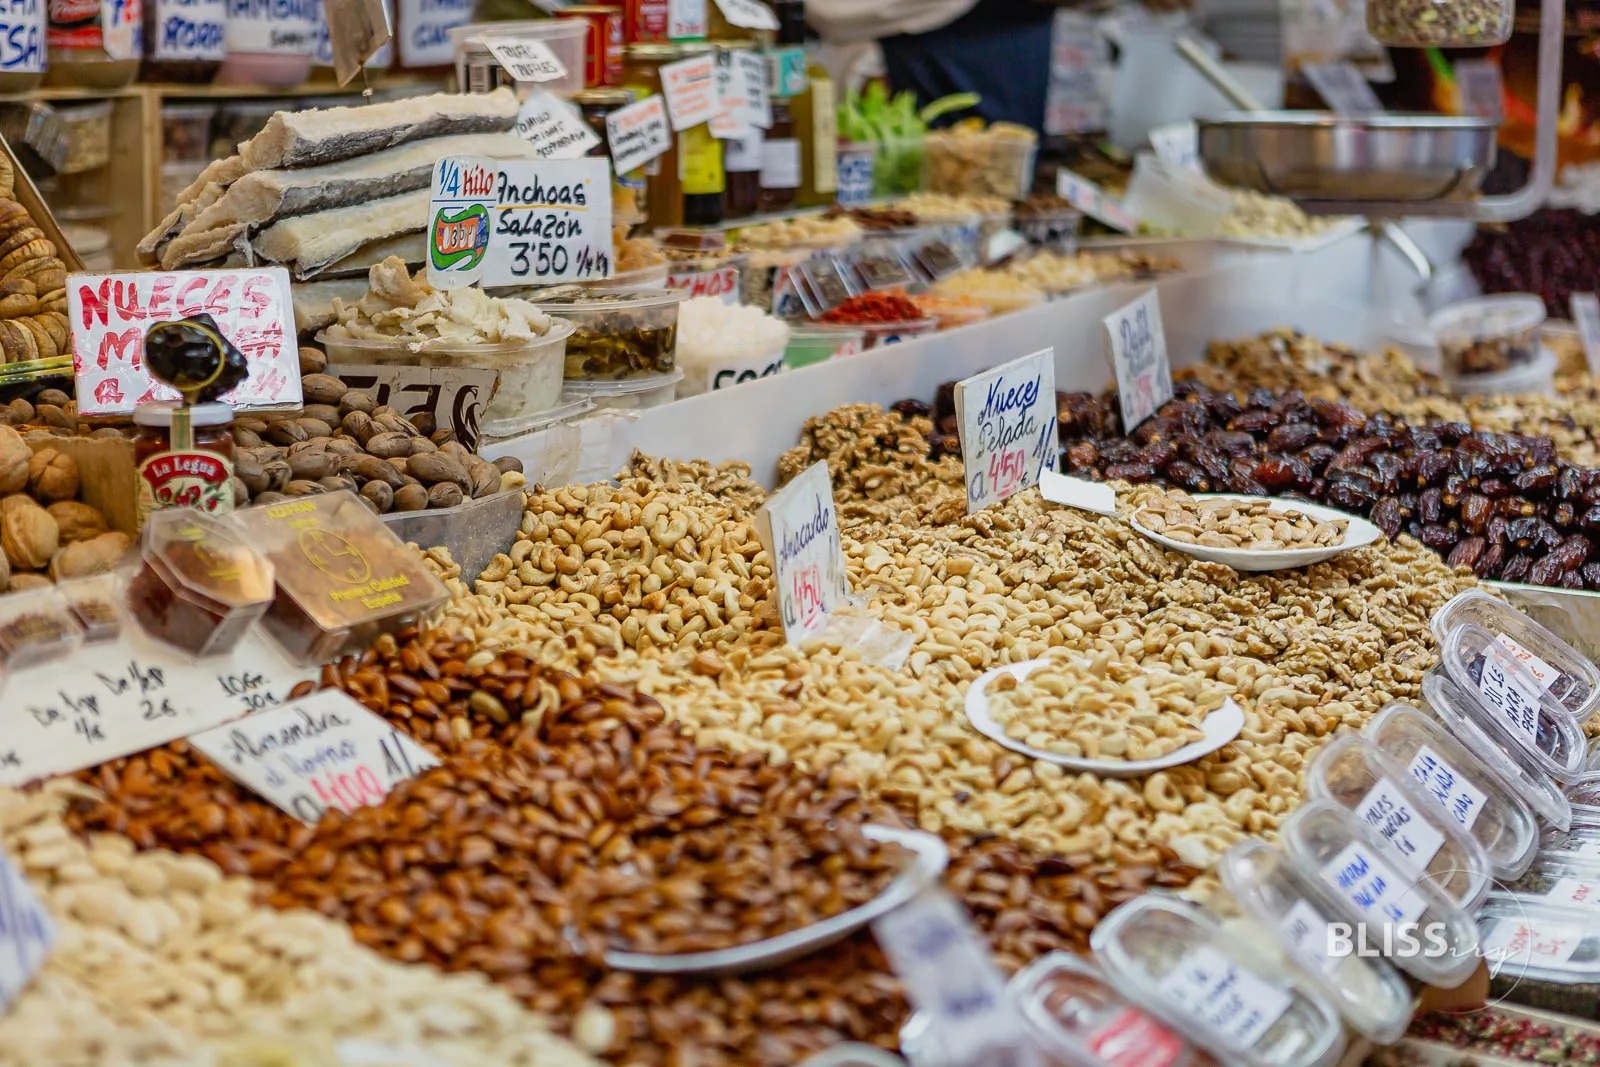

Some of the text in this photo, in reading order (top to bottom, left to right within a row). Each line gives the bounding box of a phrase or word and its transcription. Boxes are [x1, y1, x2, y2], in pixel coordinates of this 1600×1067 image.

[498, 171, 586, 206] Anchoas
[79, 275, 274, 330] NUECES
[978, 373, 1041, 425] Nueces
[976, 413, 1039, 460] Pelada
[152, 456, 217, 478] La Legua
